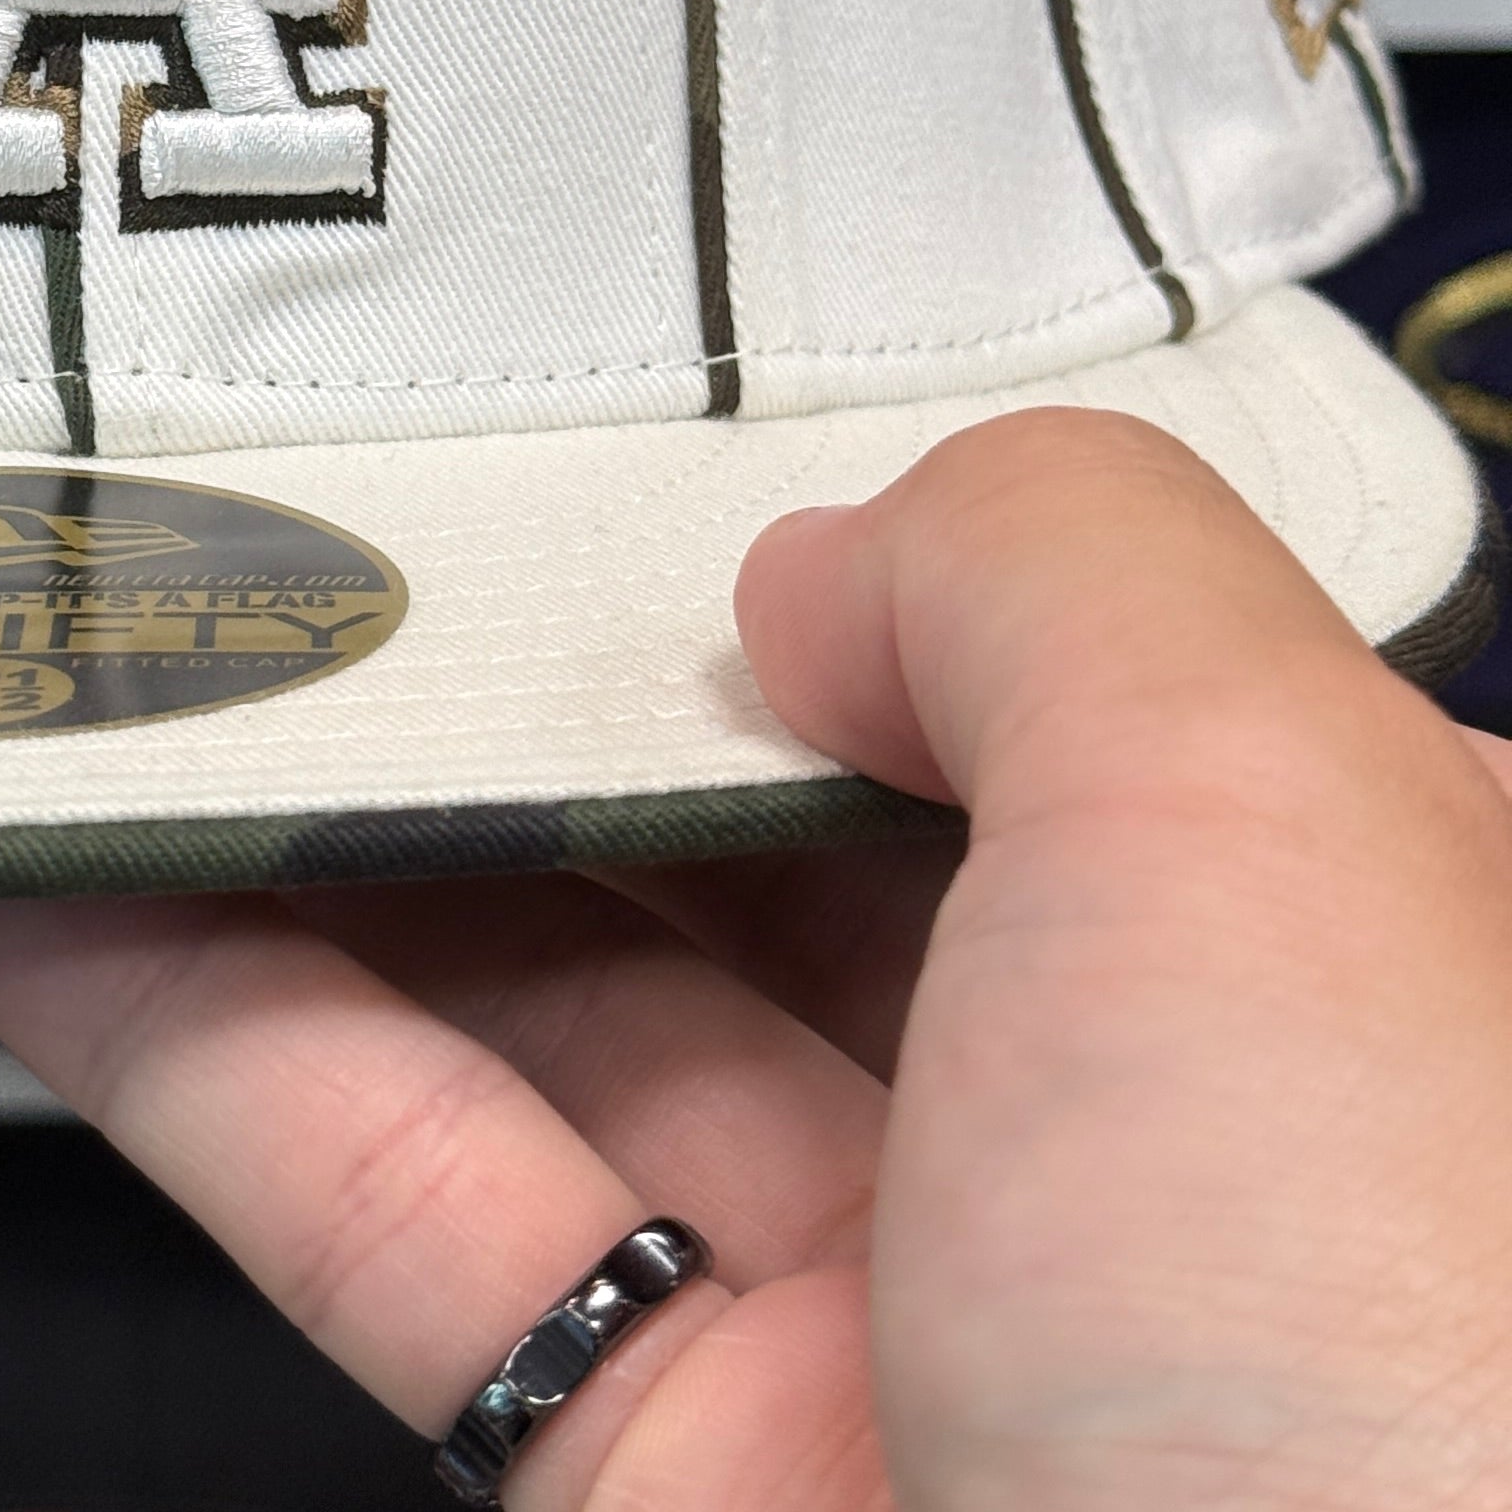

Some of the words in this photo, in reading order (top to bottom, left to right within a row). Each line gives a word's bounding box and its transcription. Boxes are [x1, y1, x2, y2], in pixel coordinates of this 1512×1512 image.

[154, 591, 191, 608] A
[207, 591, 336, 608] FLAG
[70, 656, 211, 669] FITTED
[227, 656, 304, 669] CAP
